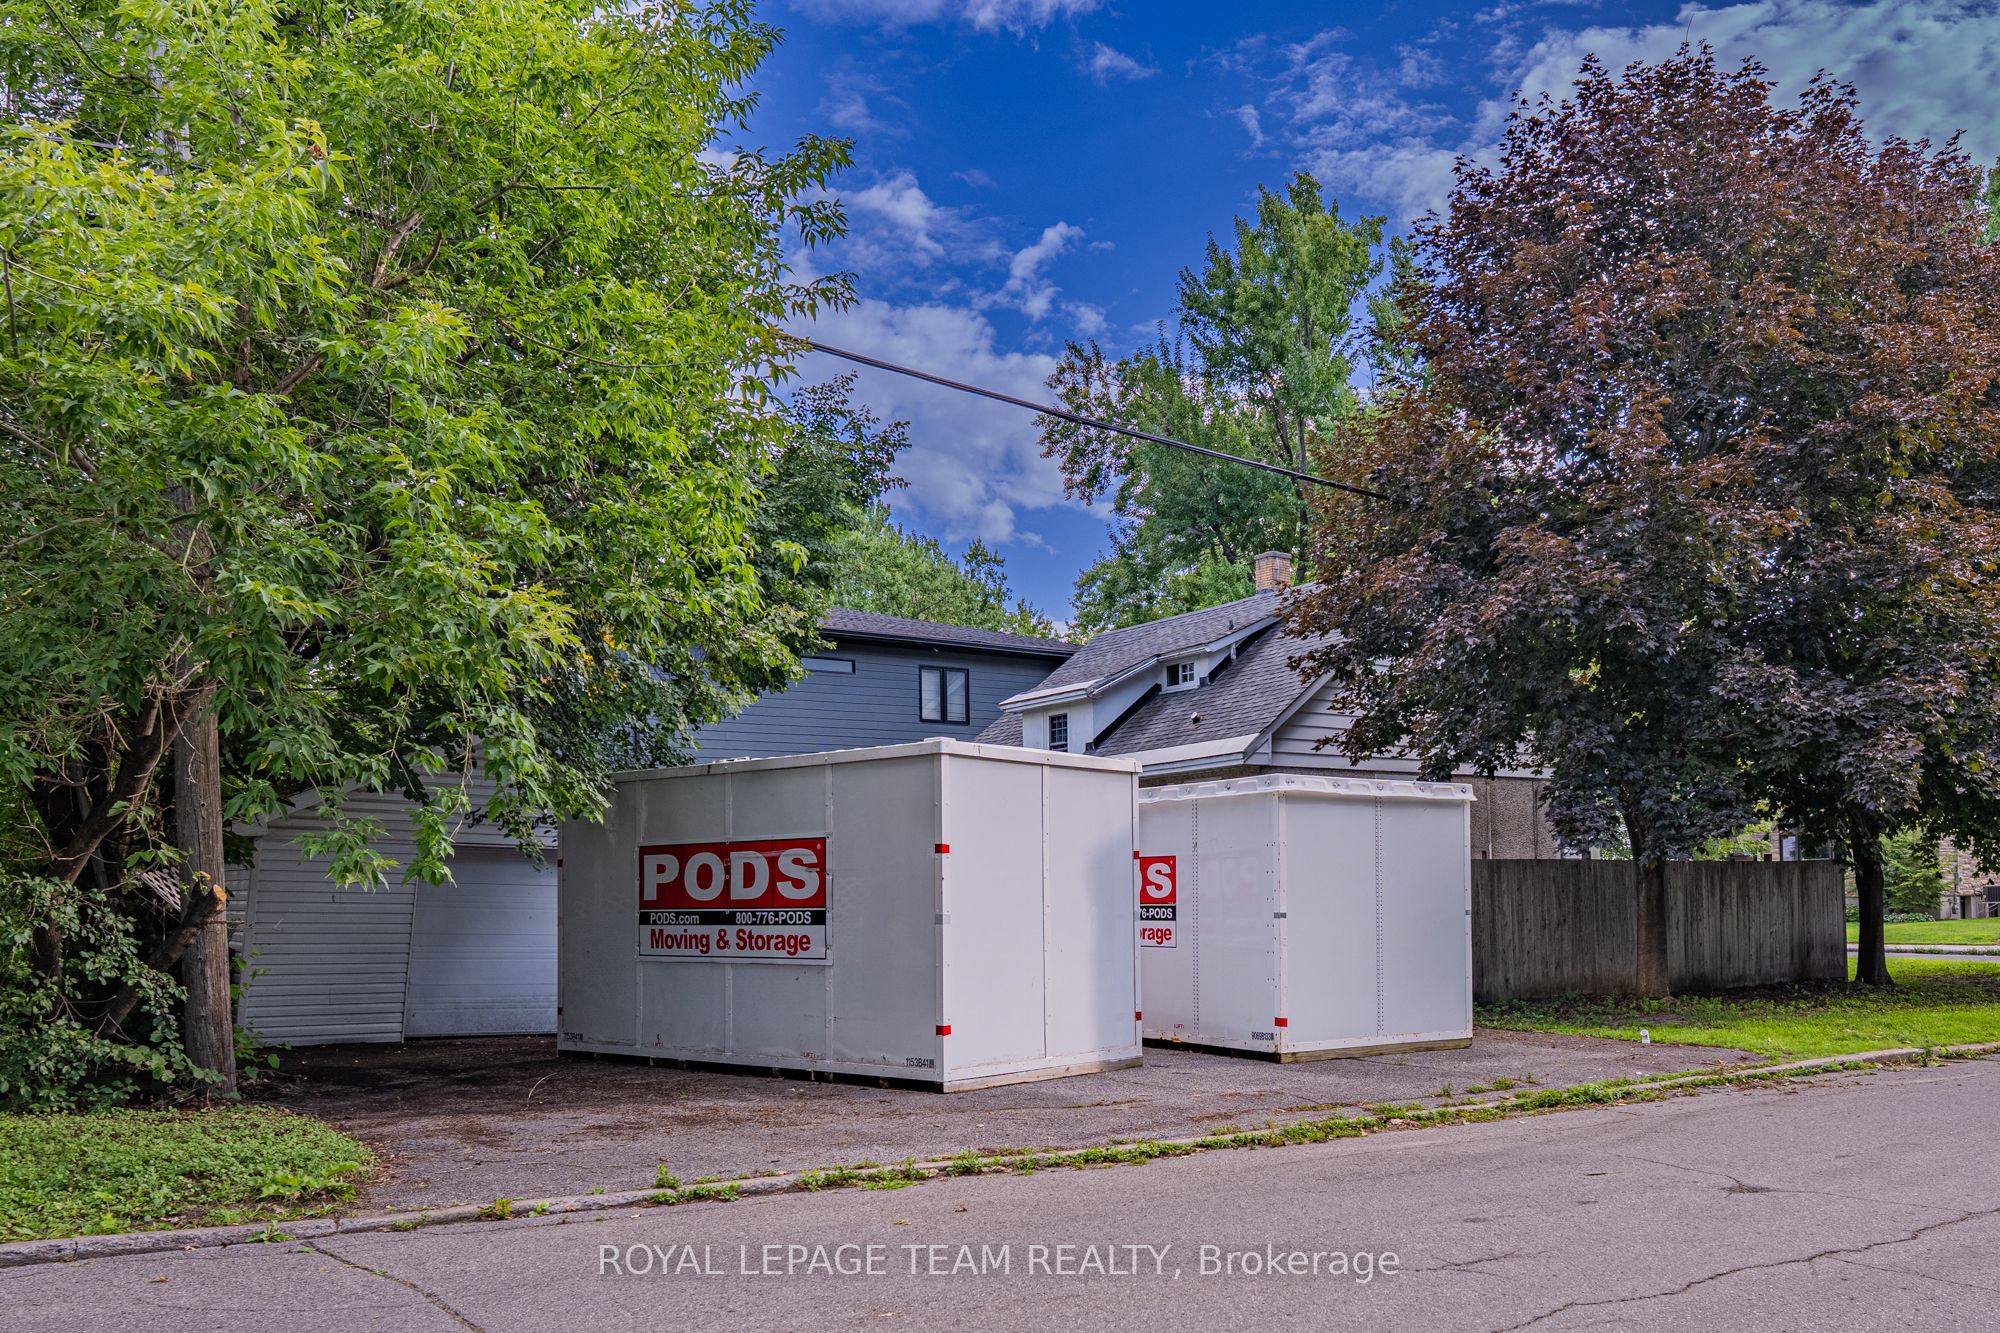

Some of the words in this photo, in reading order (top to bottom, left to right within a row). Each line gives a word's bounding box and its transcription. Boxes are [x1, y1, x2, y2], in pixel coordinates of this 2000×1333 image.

[643, 847, 820, 901] PODS
[1139, 862, 1173, 898] S
[650, 912, 700, 925] PODS.com
[735, 911, 812, 925] 800-776-PODS
[650, 928, 710, 955] Moving
[716, 928, 730, 950] &
[735, 928, 811, 956] Storage
[1140, 927, 1172, 945] rage
